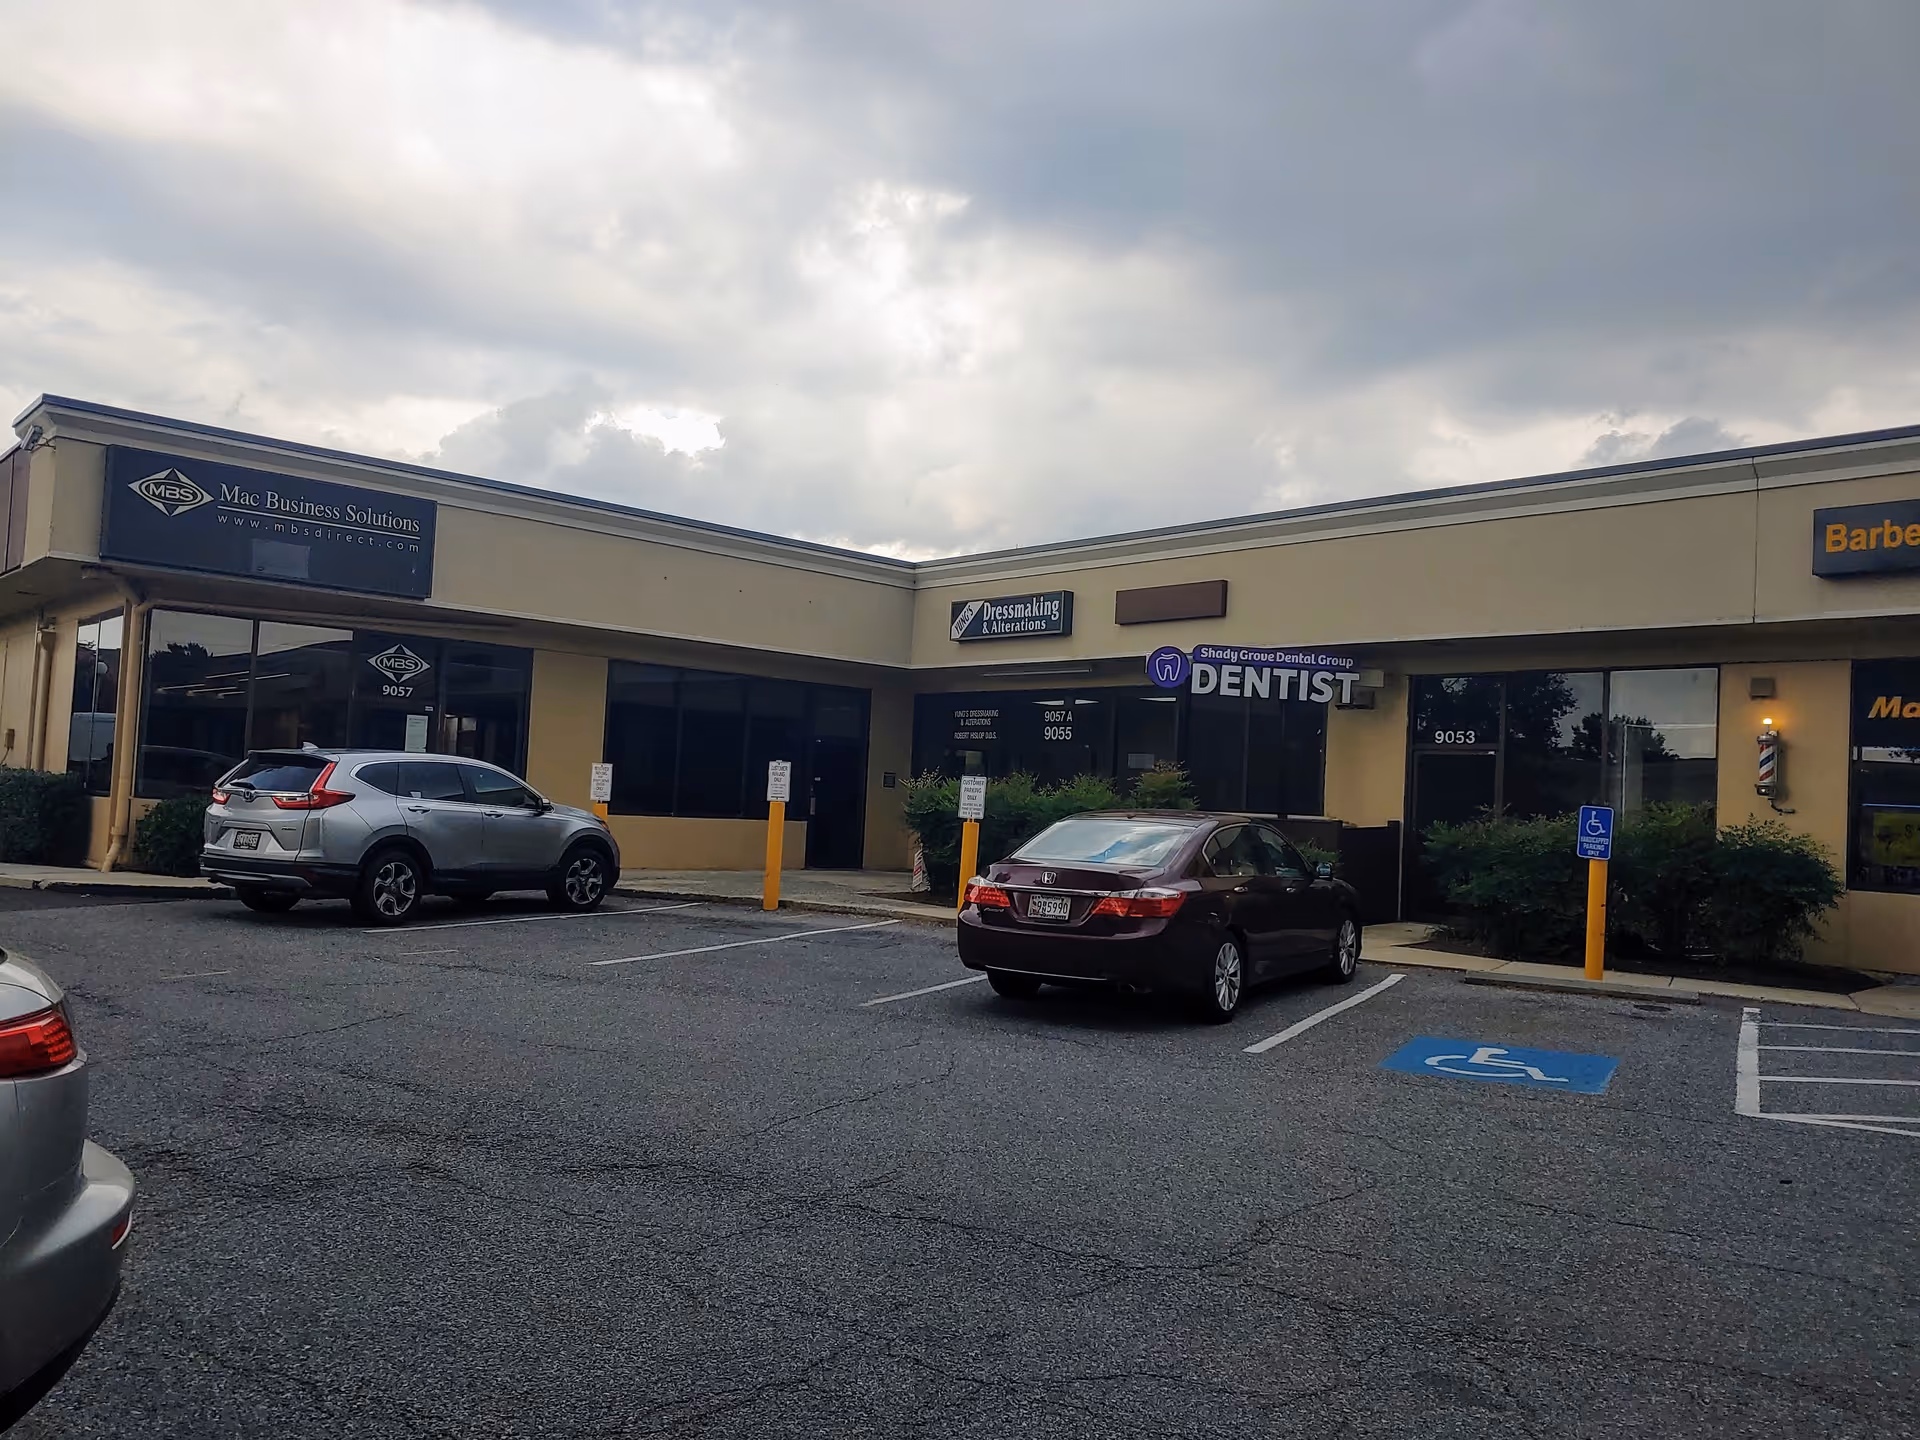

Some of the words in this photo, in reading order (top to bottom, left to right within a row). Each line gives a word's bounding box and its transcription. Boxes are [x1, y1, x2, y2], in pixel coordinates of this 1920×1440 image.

[149, 483, 195, 502] MBS
[219, 482, 260, 507] Mac
[265, 490, 340, 520] Business
[345, 504, 420, 533] Solutions
[217, 515, 419, 552] www.mbsdirect.com
[983, 596, 1060, 621] Dressmaking
[982, 621, 989, 634] &
[991, 618, 1046, 634] Alterations
[382, 657, 416, 670] MBS
[1200, 647, 1238, 663] Shady
[1239, 650, 1275, 662] Grove
[1276, 651, 1316, 665] Dental
[1318, 654, 1354, 669] Group
[382, 684, 414, 698] 9057
[1191, 662, 1360, 704] DENTIST
[1044, 710, 1065, 722] 9057
[1066, 710, 1073, 722] A
[1044, 726, 1072, 740] 9055
[1434, 730, 1476, 744] 9053
